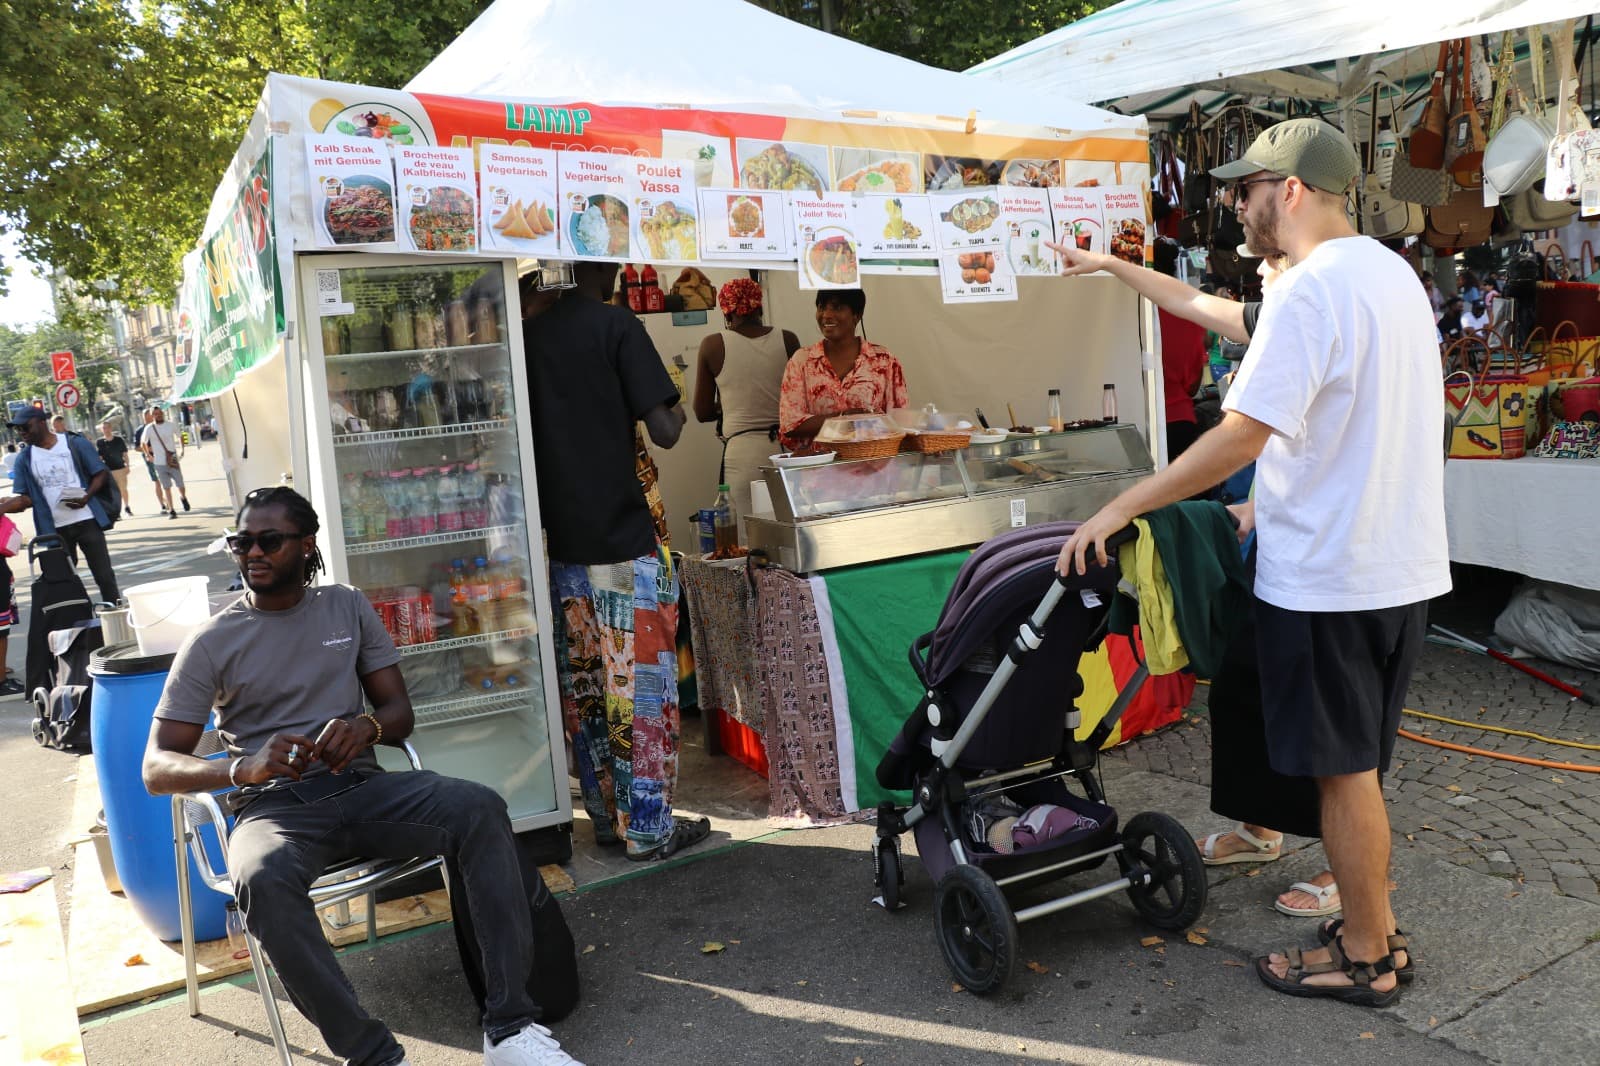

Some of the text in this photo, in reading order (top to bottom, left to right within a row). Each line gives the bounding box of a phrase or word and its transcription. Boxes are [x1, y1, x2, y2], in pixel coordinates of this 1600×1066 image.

[505, 102, 592, 136] LAMP
[314, 144, 375, 154] Kalb Steak
[314, 156, 382, 166] mit Gemüse
[403, 150, 460, 162] Brochettes
[490, 151, 544, 166] Samossas
[414, 159, 455, 170] de veau
[487, 164, 548, 178] Vegetarisch
[579, 160, 608, 171] Thiou
[636, 163, 682, 178] Poulet
[403, 167, 467, 180] (Kalbfleisch)
[564, 171, 624, 184] Vegetarisch
[640, 179, 680, 194] Yassa
